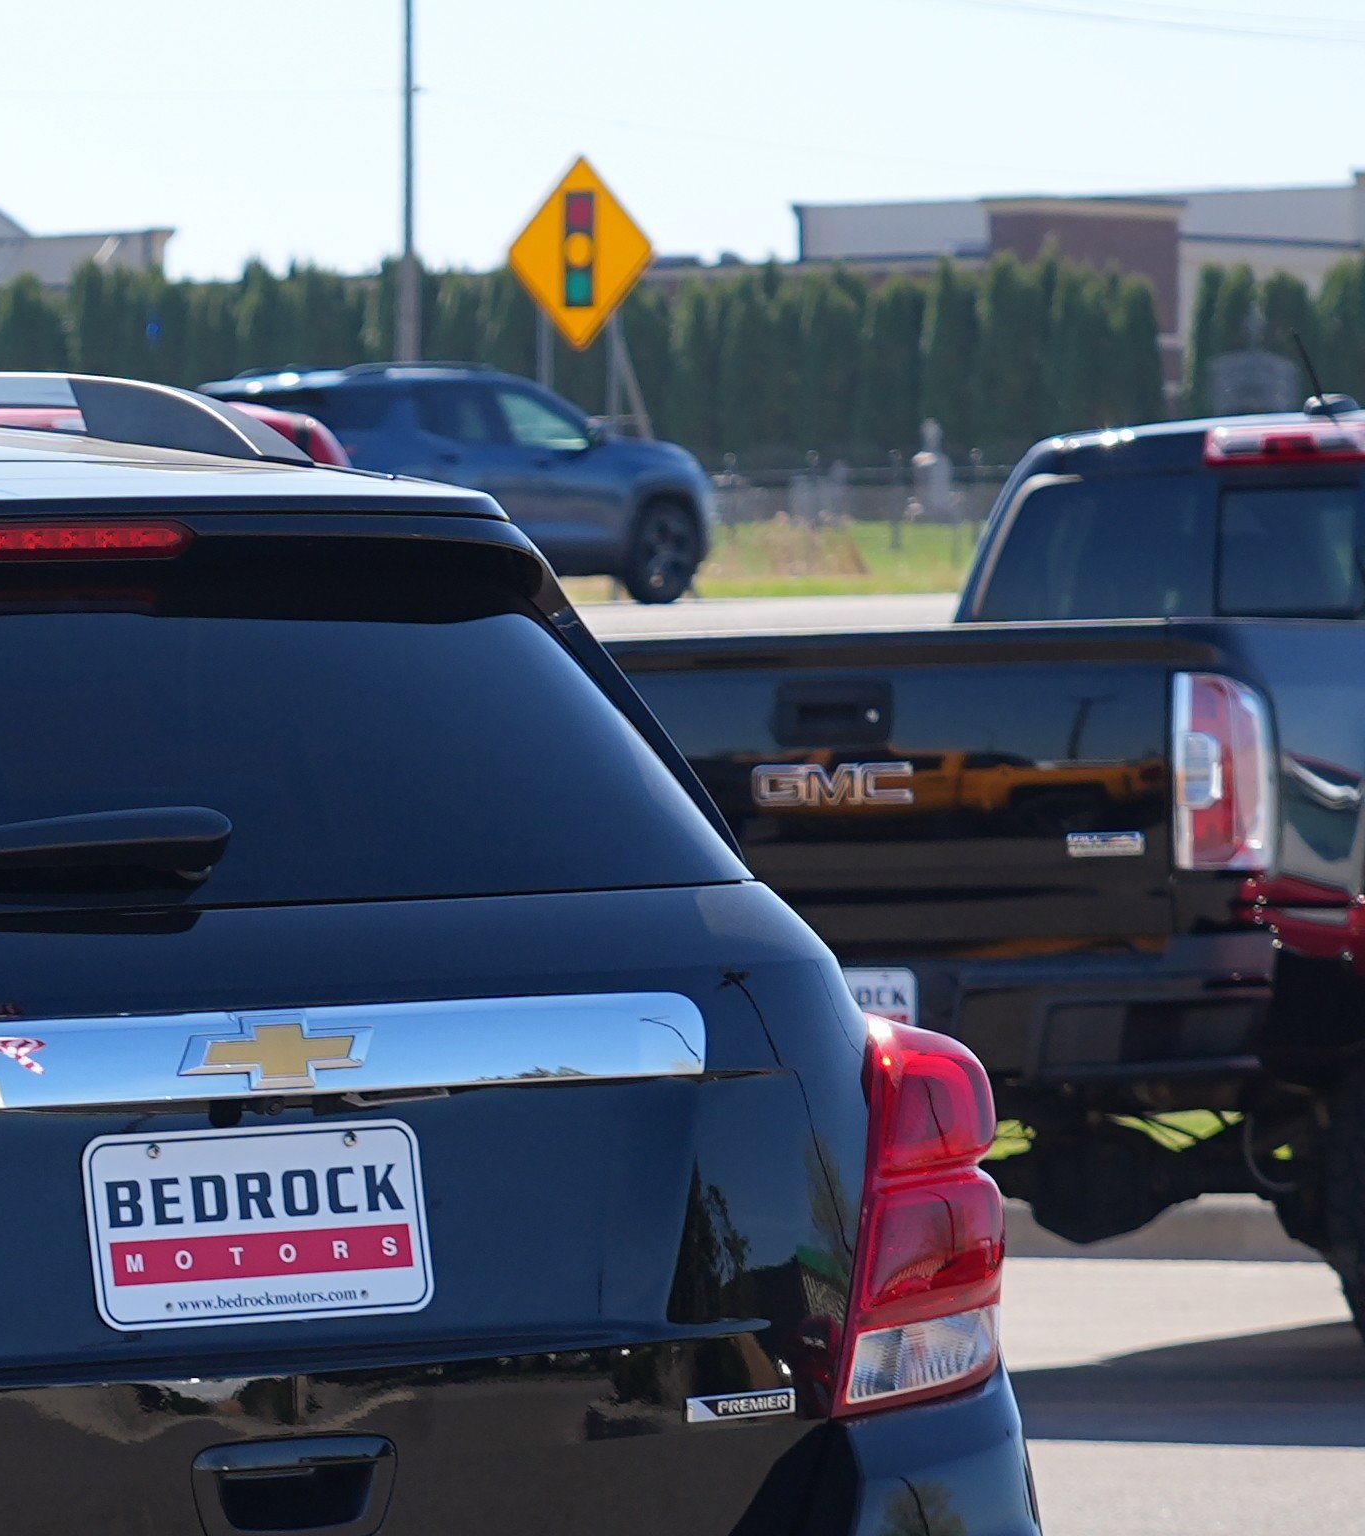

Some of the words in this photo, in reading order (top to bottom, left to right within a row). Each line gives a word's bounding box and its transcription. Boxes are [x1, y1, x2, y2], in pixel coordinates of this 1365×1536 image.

[751, 761, 914, 807] GMC
[855, 985, 909, 1008] OCK
[104, 1163, 405, 1229] BEDROCK
[125, 1236, 399, 1273] MOTORS
[176, 1287, 358, 1312] www.bedrockmotors.com
[717, 1394, 789, 1415] PREMIER
